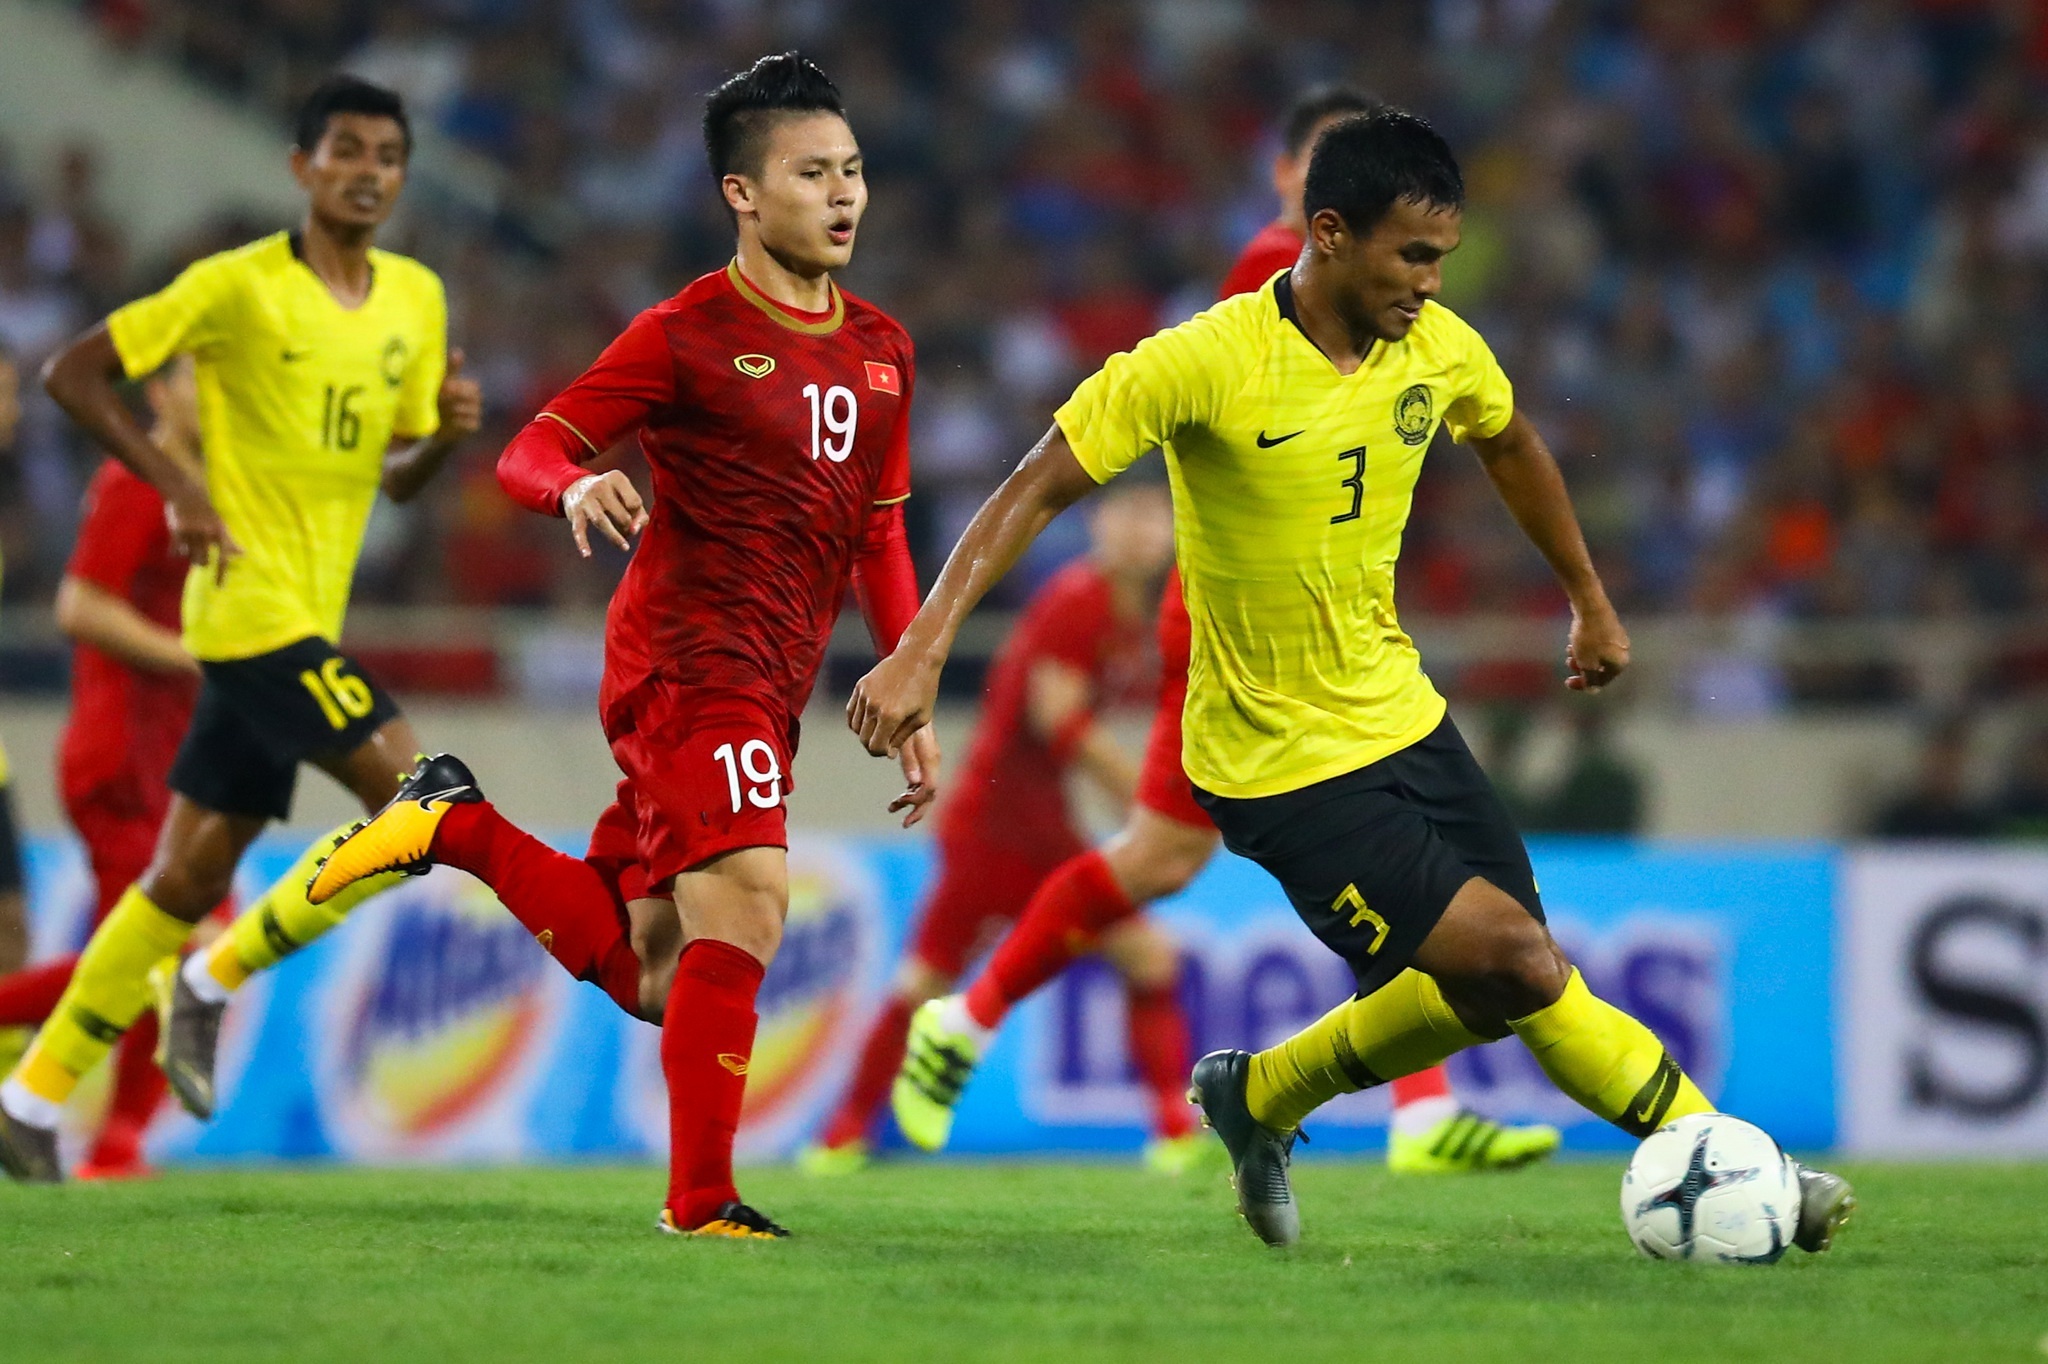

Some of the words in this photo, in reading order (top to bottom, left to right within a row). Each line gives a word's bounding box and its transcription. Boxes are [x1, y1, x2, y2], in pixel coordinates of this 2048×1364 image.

[322, 385, 365, 451] 16
[802, 383, 858, 463] 19
[1330, 446, 1367, 525] 3
[299, 657, 374, 730] 16
[713, 739, 782, 814] 19
[1331, 882, 1391, 956] 3
